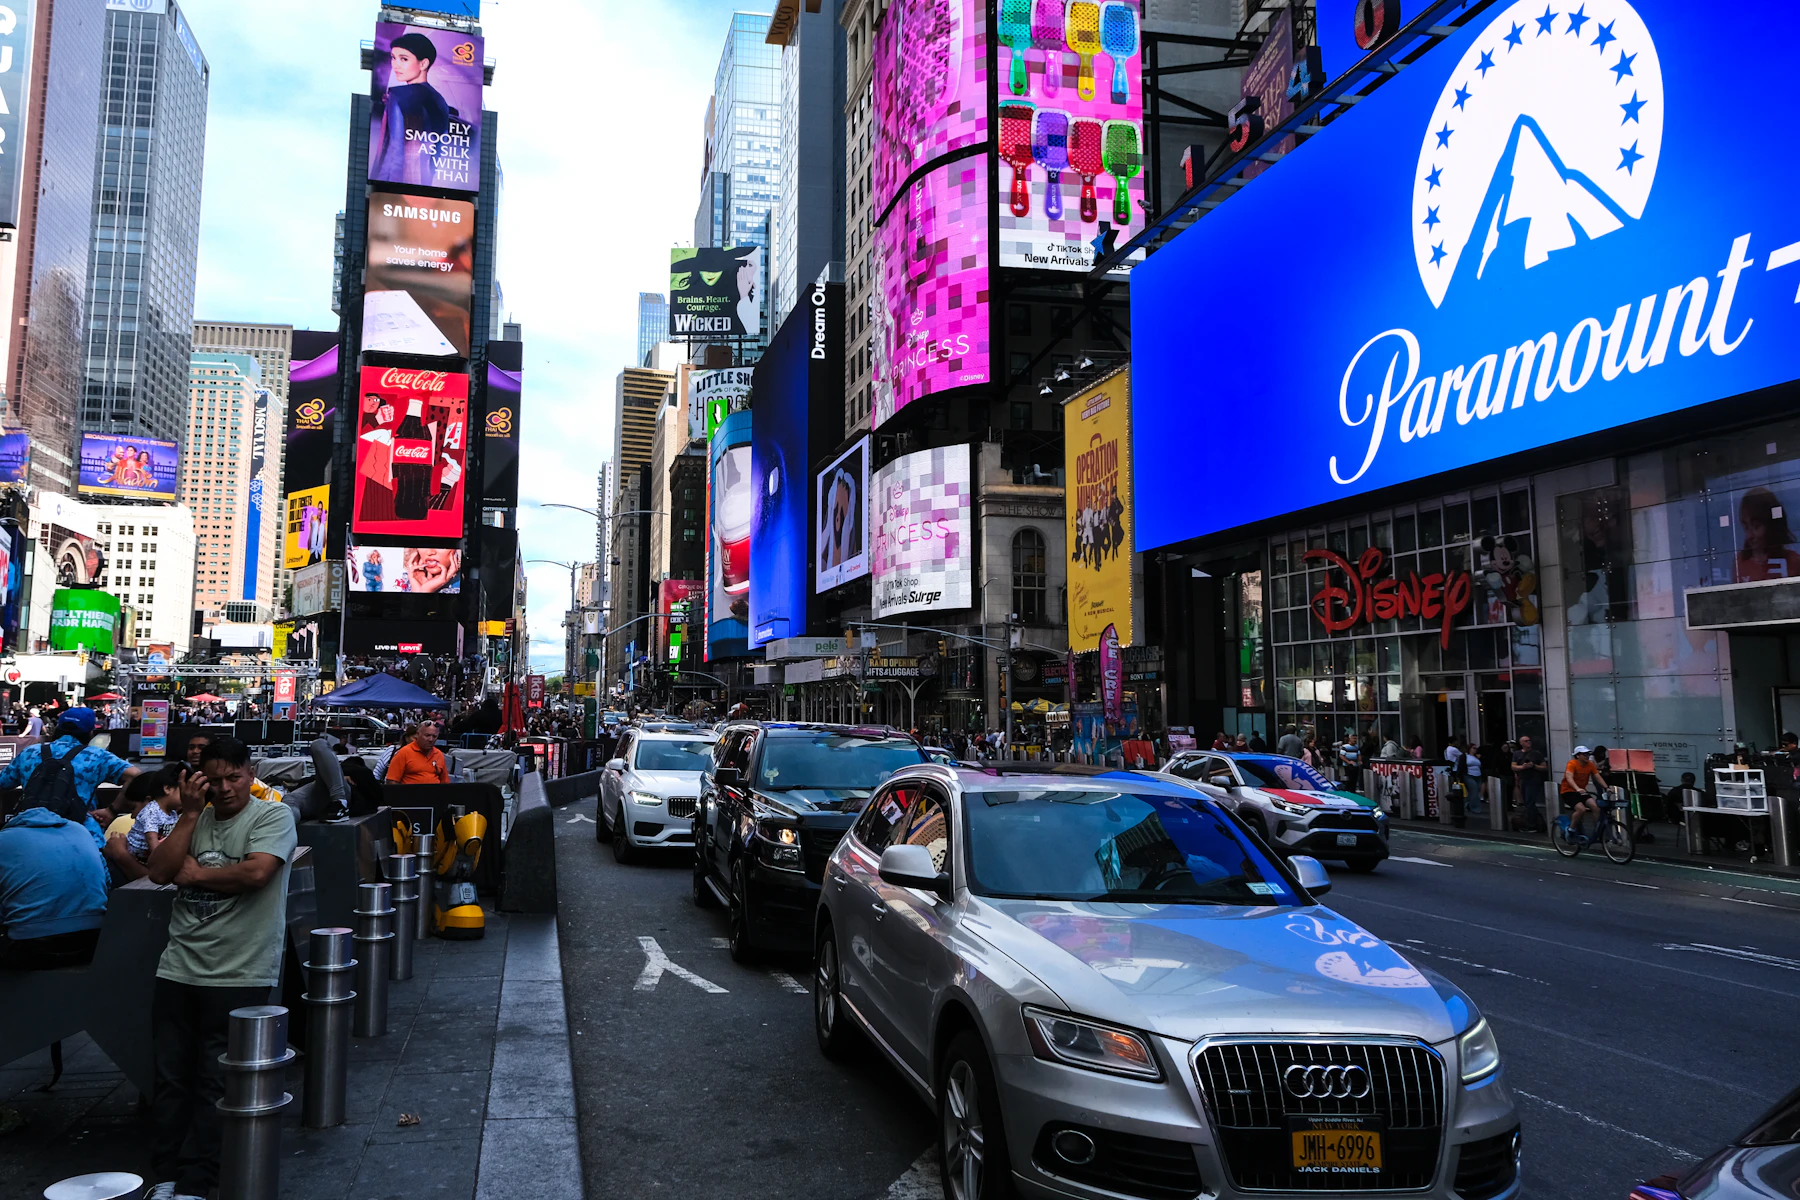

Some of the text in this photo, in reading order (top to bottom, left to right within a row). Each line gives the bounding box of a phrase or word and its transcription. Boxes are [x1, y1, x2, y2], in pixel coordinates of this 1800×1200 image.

[450, 123, 471, 135] FLY
[405, 129, 470, 148] SMOOTH
[418, 143, 470, 160] AS SILK
[432, 157, 469, 171] WITH
[435, 169, 469, 183] THAI
[383, 204, 461, 224] SAMSUNG
[394, 245, 448, 258] Your home
[1056, 244, 1082, 254] TikTok
[386, 256, 454, 272] saves energy
[1025, 253, 1089, 267] New Arrivals
[677, 295, 731, 304] Brains. Heart.
[686, 303, 721, 312] Courage.
[811, 307, 826, 360] Dream
[892, 334, 970, 386] PRINCESS
[1329, 232, 1754, 485] Paramount
[696, 371, 734, 395] LITTLE
[1076, 438, 1119, 487] OPERATION
[1001, 505, 1057, 516] THE SHOW
[876, 517, 950, 552] PRINCESS
[903, 577, 919, 587] Shop
[887, 594, 908, 608] Arrivals
[908, 590, 941, 605] Surge
[889, 658, 918, 667] OPENING
[1104, 628, 1119, 721] ICE CREAM
[137, 683, 170, 691] KLIKTIX
[530, 676, 542, 699] tkts
[1370, 762, 1423, 779] CHICAGO
[1426, 765, 1437, 818] CHICAGO
[1299, 1135, 1375, 1160] JMH 6996
